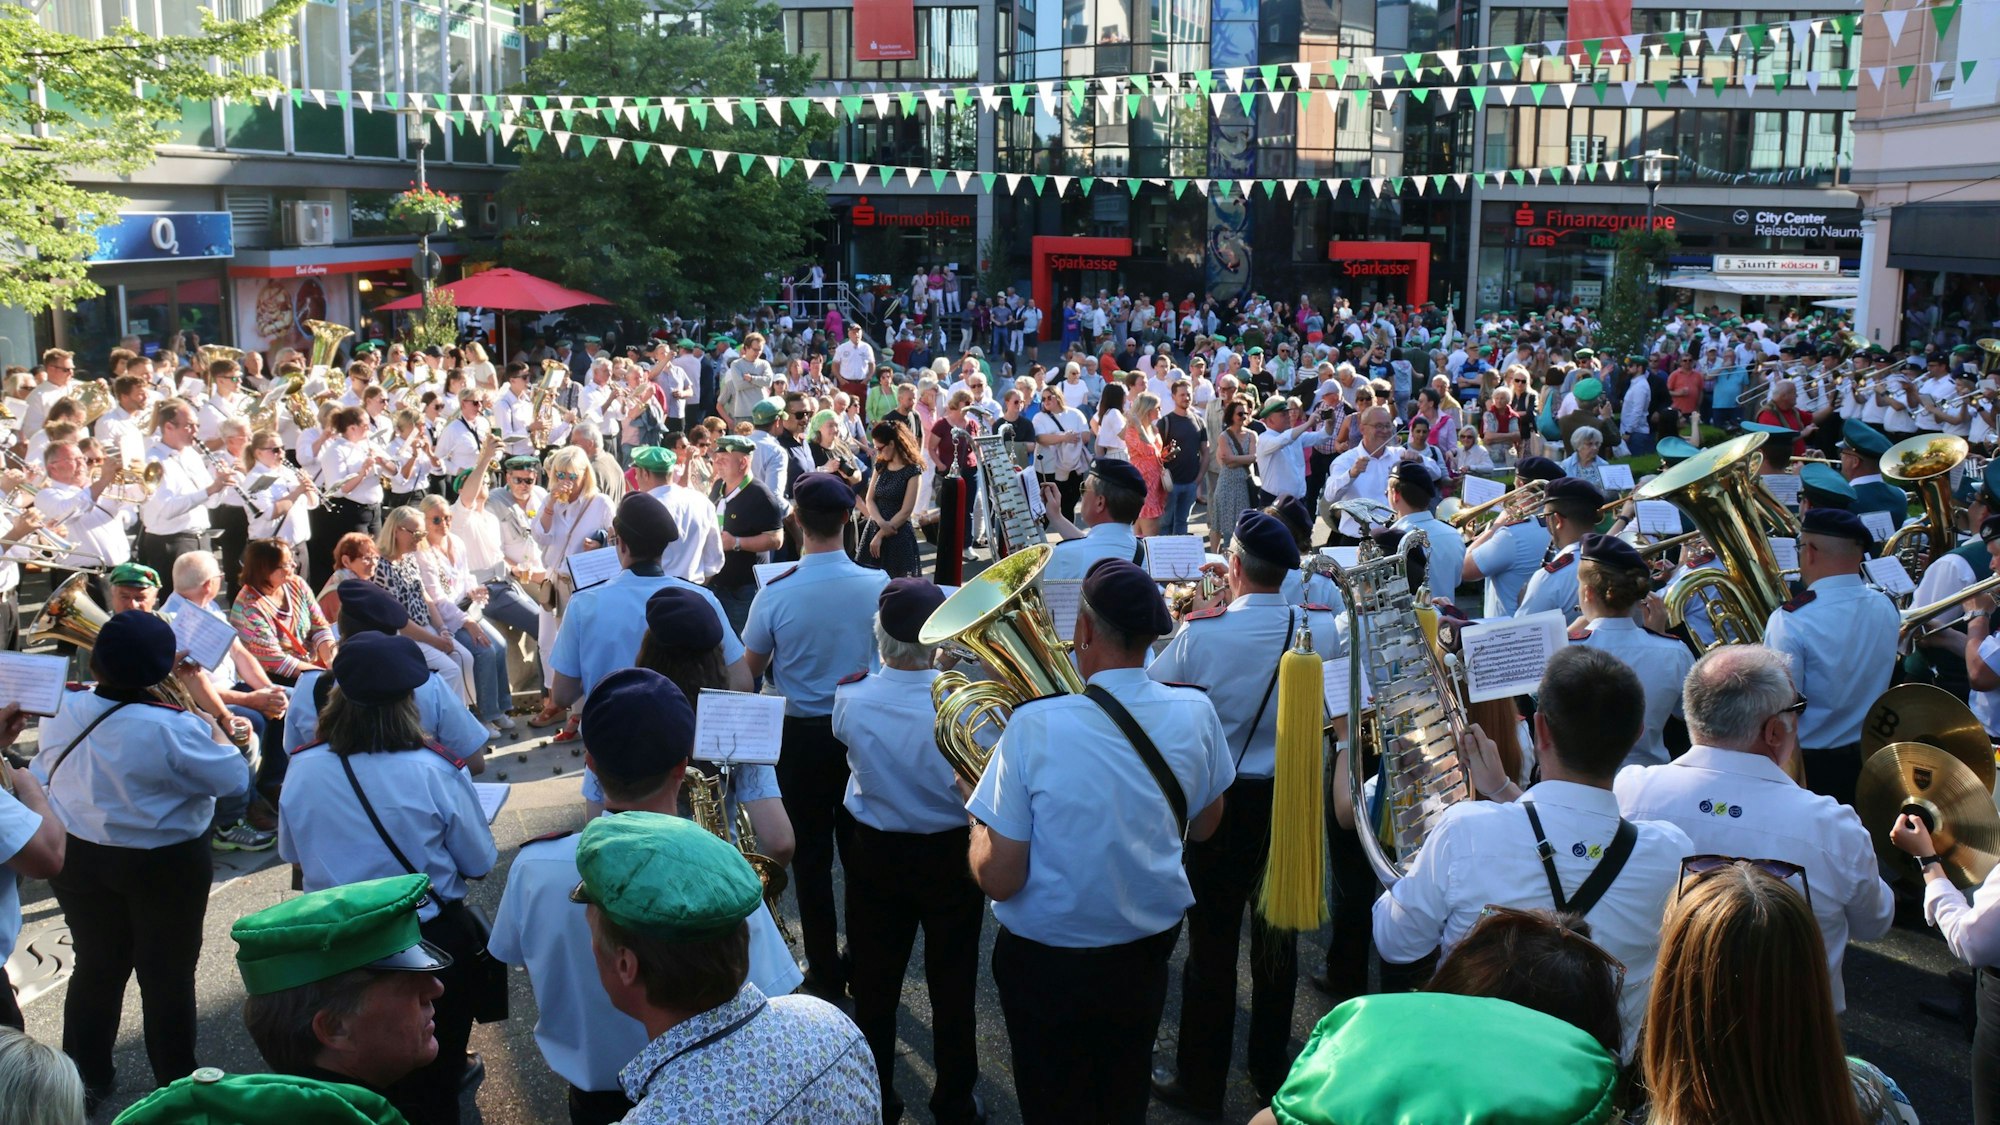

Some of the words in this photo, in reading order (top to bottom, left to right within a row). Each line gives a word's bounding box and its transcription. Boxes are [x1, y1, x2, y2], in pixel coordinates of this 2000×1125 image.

[879, 210, 970, 226] Immobilien
[1756, 211, 1782, 226] City
[1784, 212, 1826, 224] Center
[1755, 224, 1818, 237] Reisebüro
[1528, 234, 1556, 247] LBS
[1051, 255, 1117, 271] Sparkasse
[1343, 260, 1409, 277] Sparkasse
[1780, 259, 1819, 270] KÖLSCH
